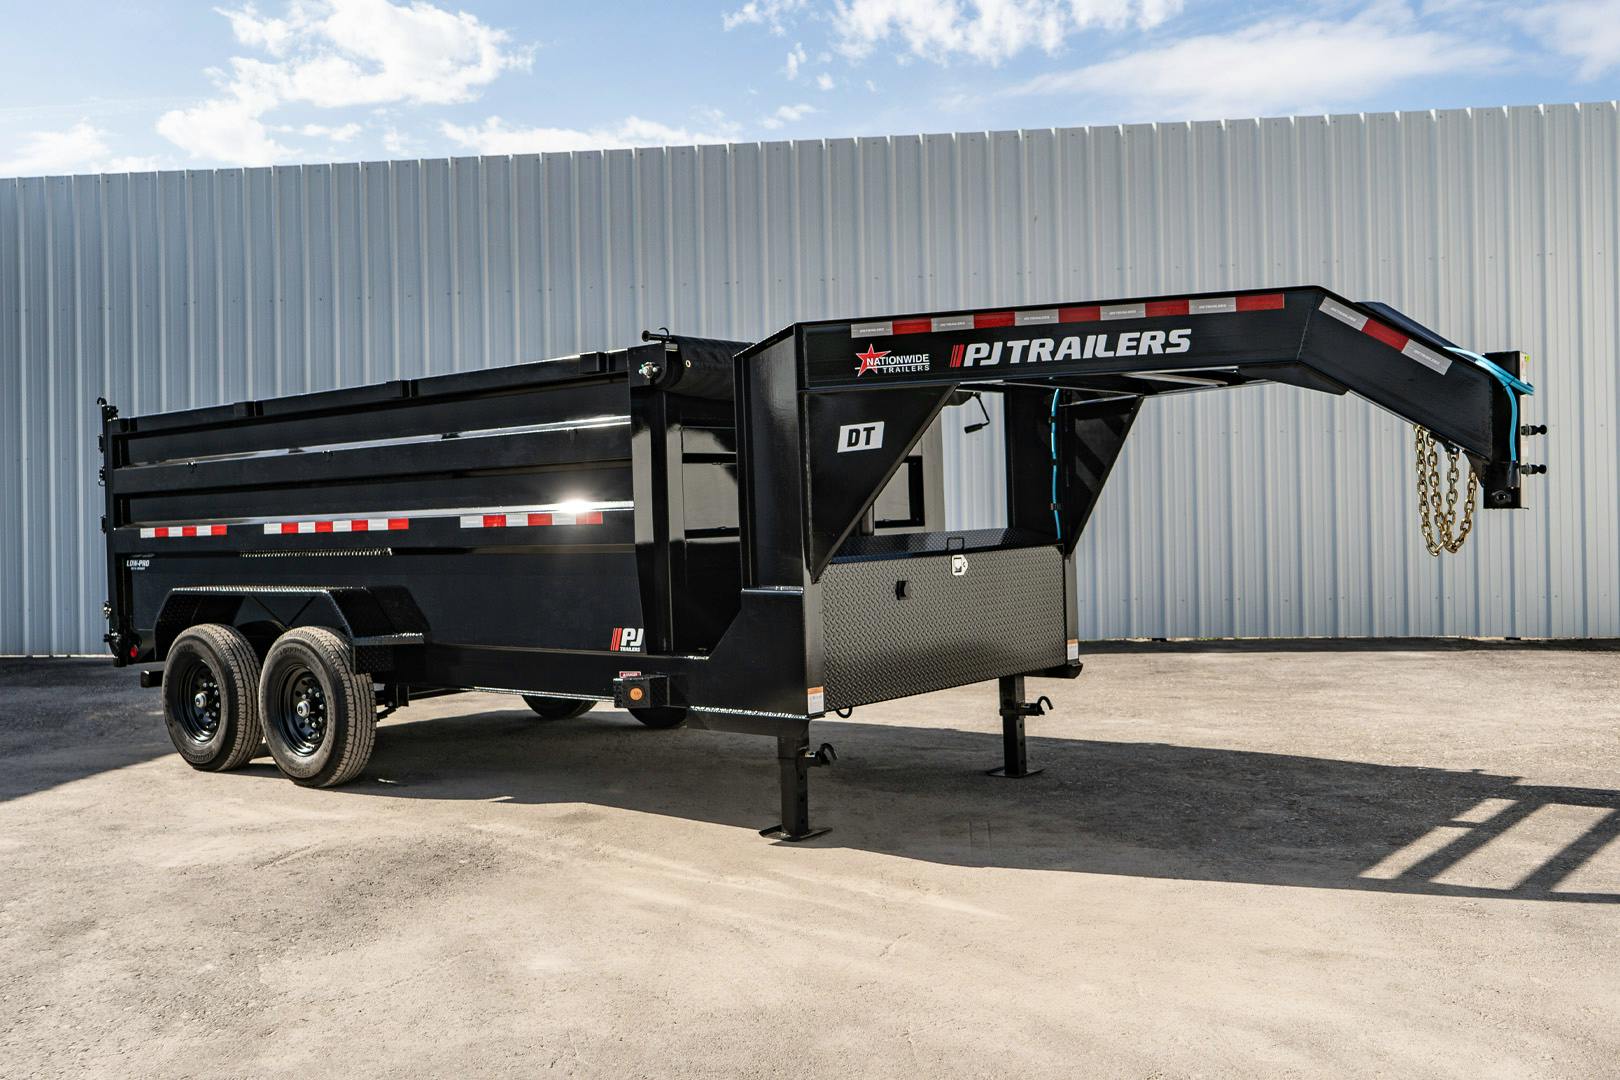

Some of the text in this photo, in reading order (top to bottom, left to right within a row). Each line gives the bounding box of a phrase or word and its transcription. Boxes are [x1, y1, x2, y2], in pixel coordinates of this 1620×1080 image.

[963, 328, 1192, 367] PJ TRAILERS
[866, 353, 930, 366] NATIONWIDE
[883, 365, 930, 374] TRAILERS
[847, 426, 876, 448] DT
[126, 559, 150, 567] LOW-PRO
[620, 627, 644, 647] PJ
